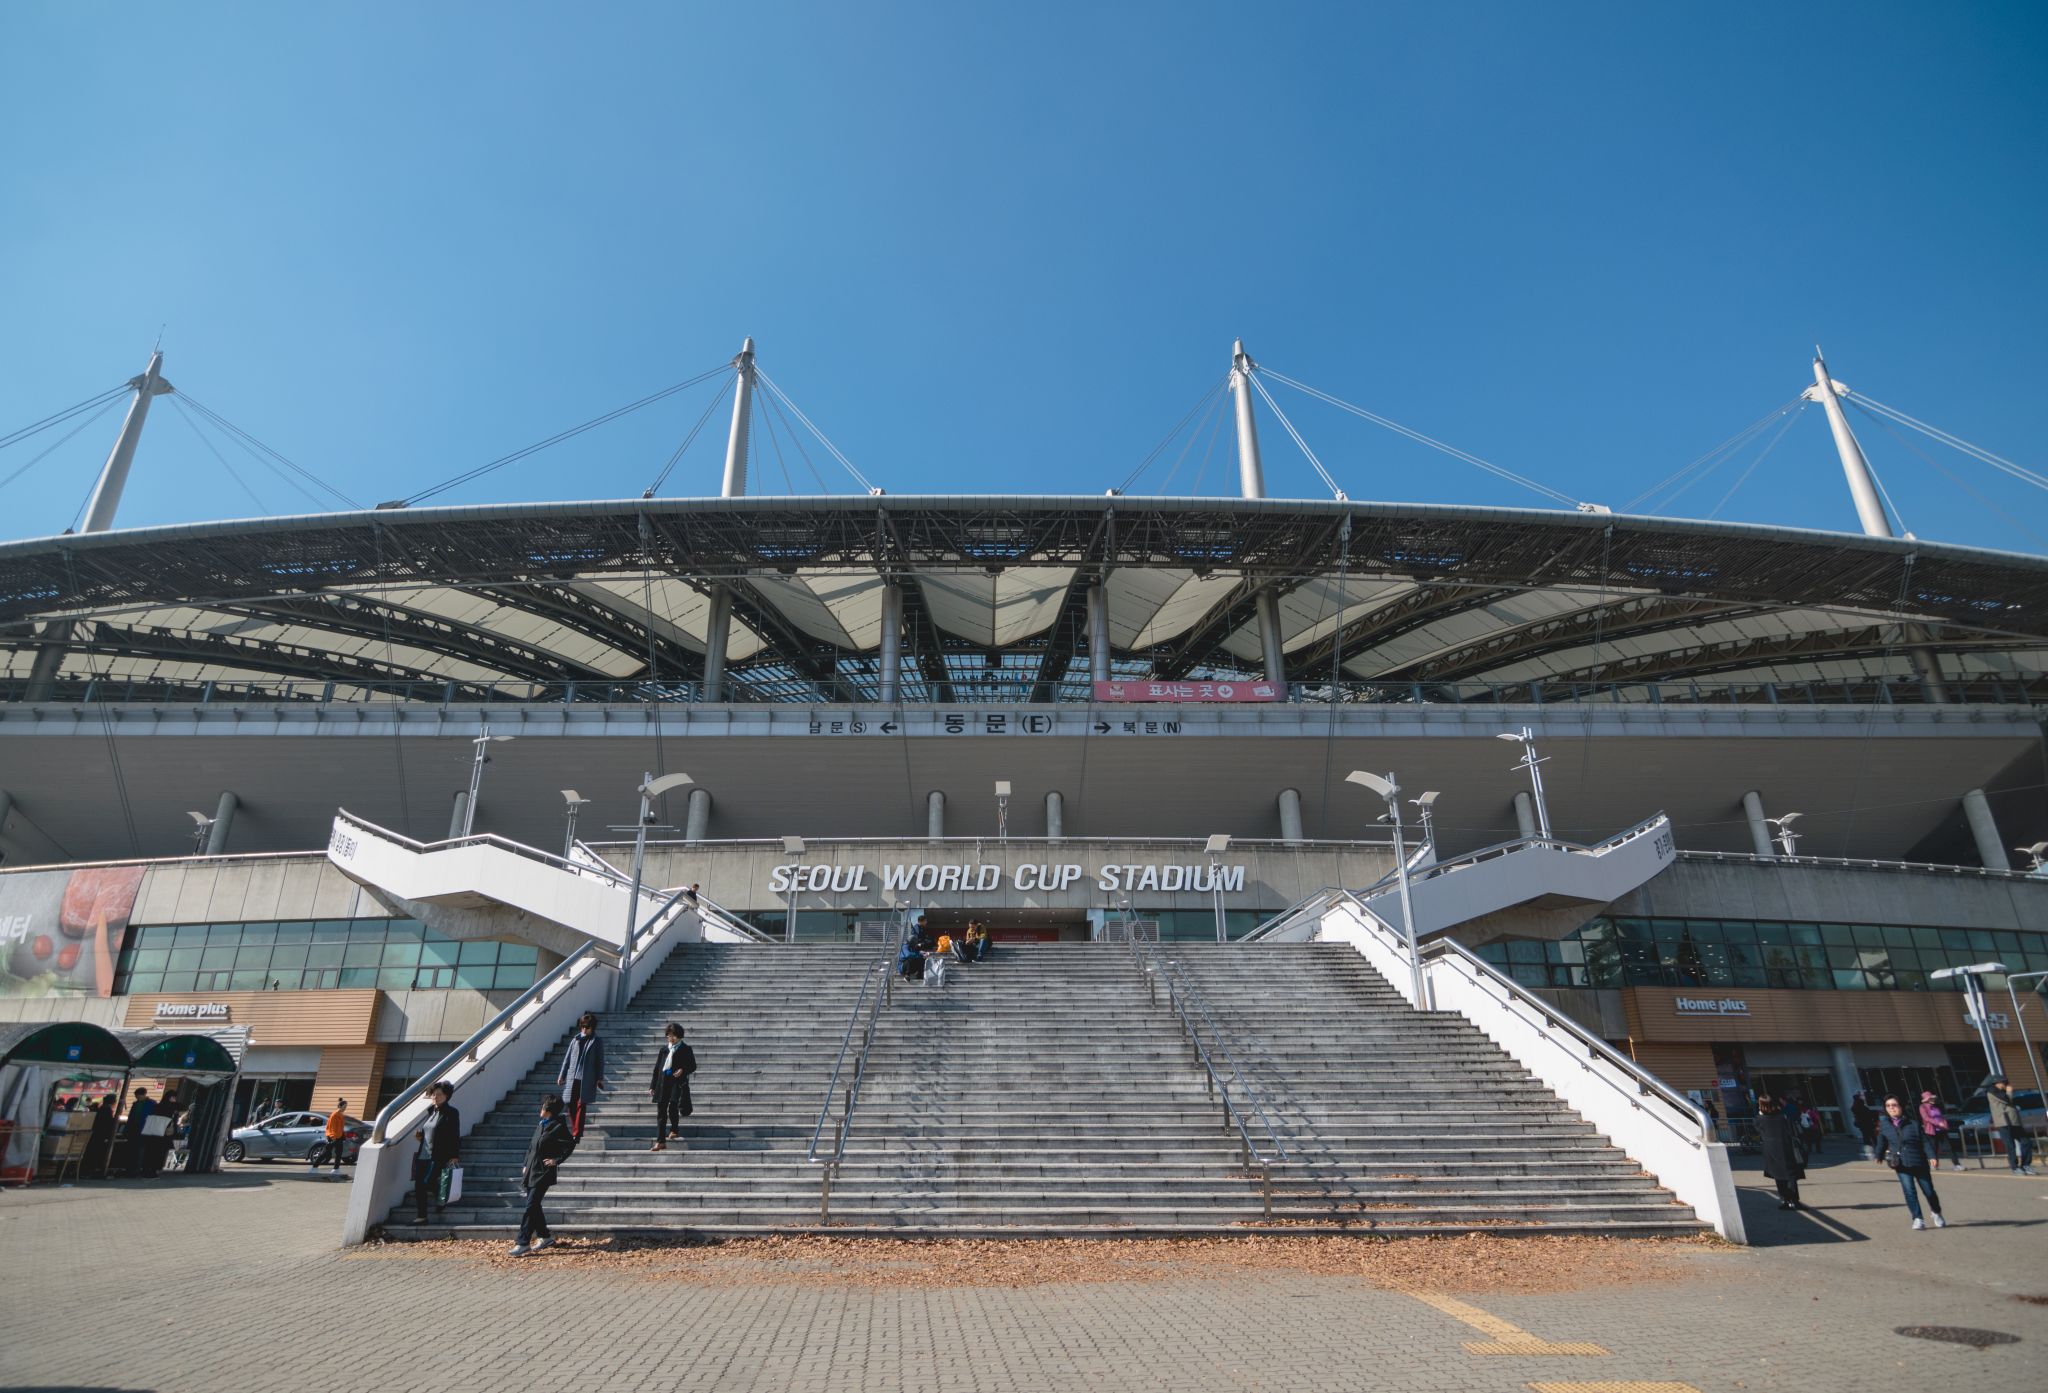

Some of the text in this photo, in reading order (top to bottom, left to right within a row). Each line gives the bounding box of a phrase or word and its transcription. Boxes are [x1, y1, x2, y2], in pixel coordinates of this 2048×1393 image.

[1148, 684, 1214, 698] 표사는 곳
[768, 864, 1245, 892] SEOUL WORLD CUP STADIUM
[155, 1002, 228, 1018] Home plus
[1675, 997, 1747, 1013] Home plus
